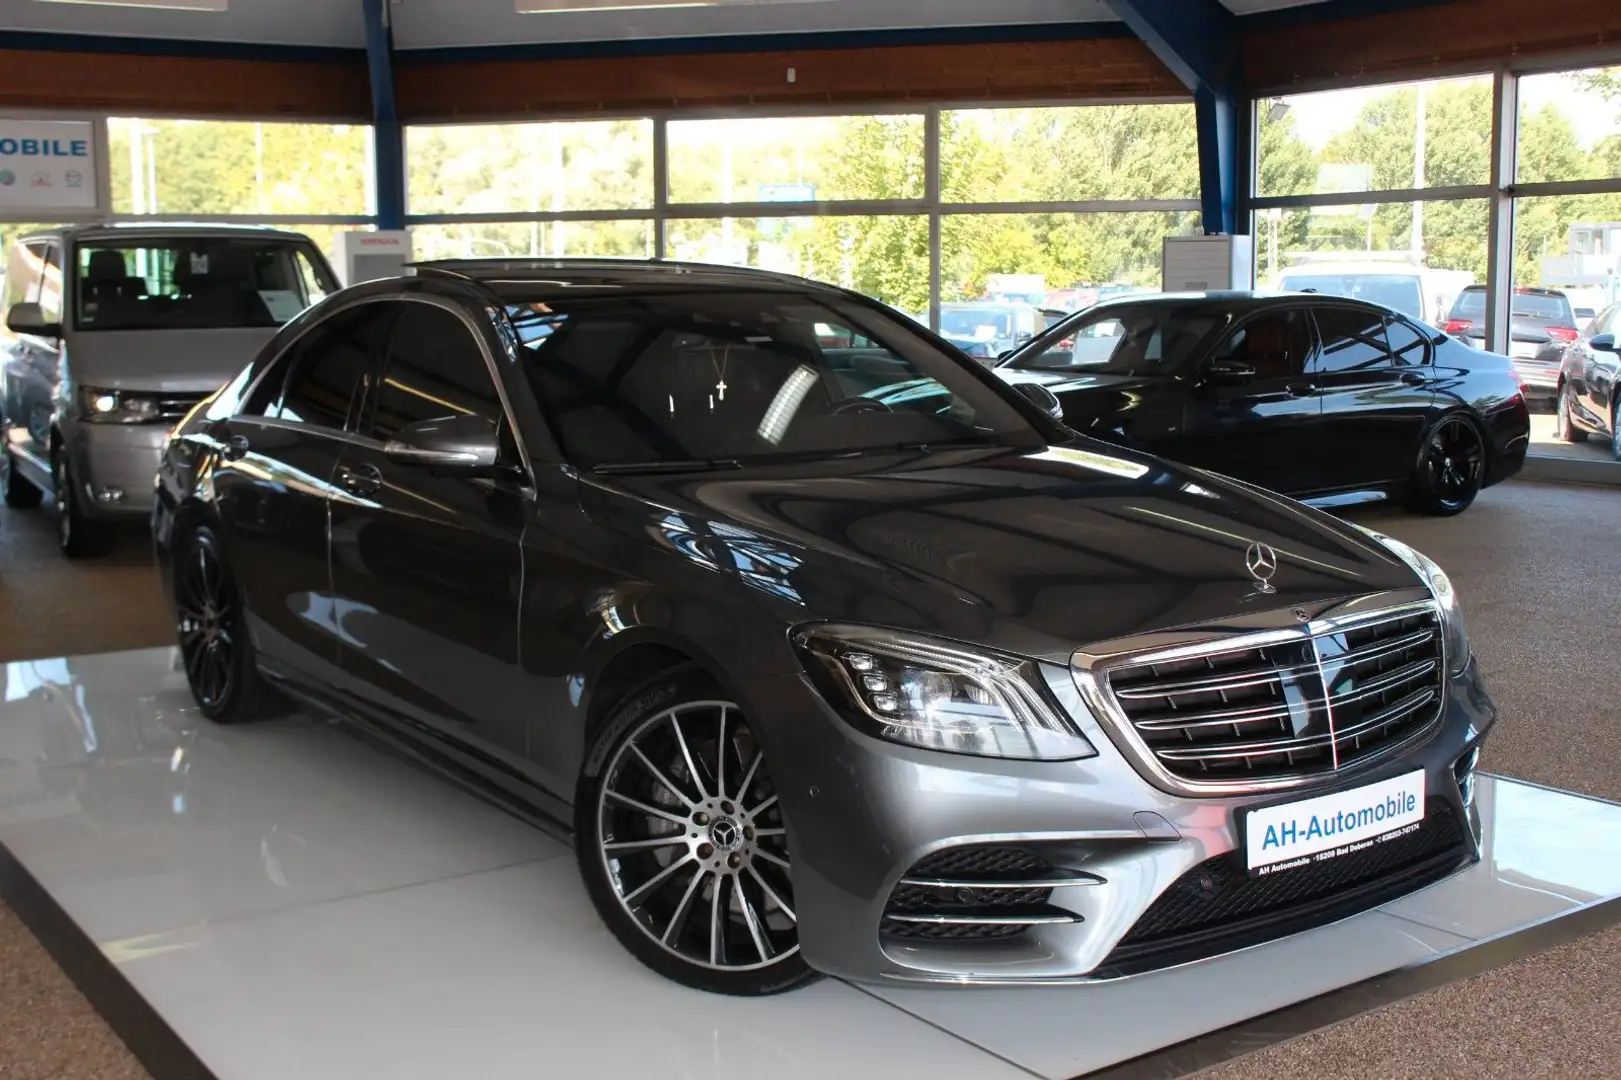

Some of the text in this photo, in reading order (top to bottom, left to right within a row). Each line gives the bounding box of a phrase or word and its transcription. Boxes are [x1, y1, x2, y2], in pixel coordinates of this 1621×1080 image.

[1262, 791, 1416, 850] AH-Automobile
[1258, 867, 1270, 876] AH
[1271, 857, 1311, 873] Automobile
[1336, 846, 1349, 857] Bad
